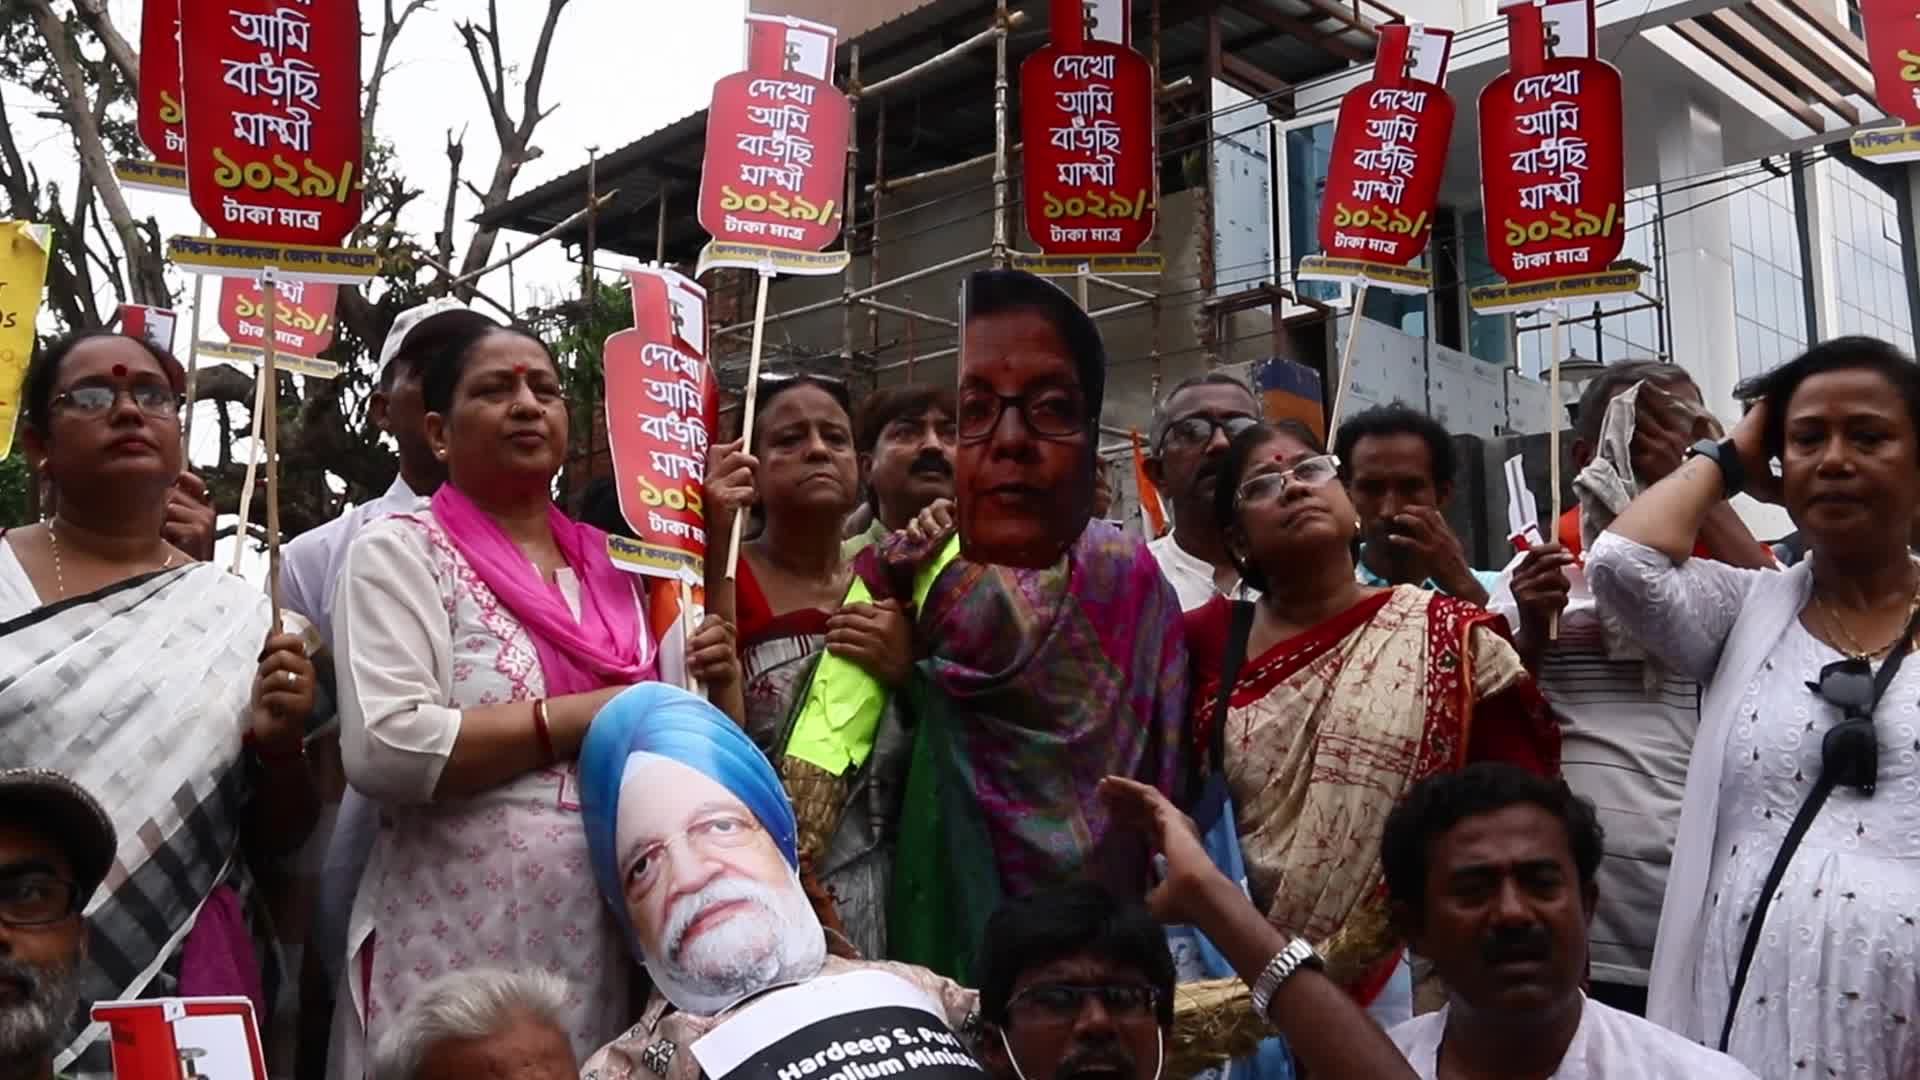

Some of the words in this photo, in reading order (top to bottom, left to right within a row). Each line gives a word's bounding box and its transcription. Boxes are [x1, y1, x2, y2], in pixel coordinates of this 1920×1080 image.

[229, 7, 310, 56] আমি
[1053, 55, 1115, 80] দেখো
[749, 79, 815, 105] দেখো
[1055, 84, 1113, 119] আমি
[1369, 88, 1427, 113] দেখো
[1513, 69, 1581, 104] দেখো
[232, 108, 312, 151] মাম্মী
[747, 105, 810, 136] আমি
[1365, 114, 1418, 143] আমি
[1515, 101, 1579, 141] আমি
[223, 195, 275, 225] টাকা
[279, 207, 321, 231] মাত্র
[724, 215, 767, 235] টাকা
[770, 223, 806, 241] মাত্র
[1050, 223, 1088, 243] টাকা
[1090, 227, 1122, 243] মাত্র
[1334, 230, 1365, 250] টাকা
[1368, 237, 1399, 256] মাত্র
[1512, 251, 1552, 271] টাকা
[1554, 246, 1591, 264] মাত্র
[641, 343, 700, 382] দেখো
[642, 378, 703, 415] আমি
[648, 510, 689, 539] টাকা
[777, 1035, 891, 1080] Hardeep
[892, 1027, 919, 1045] S.
[821, 1062, 904, 1080] olium
